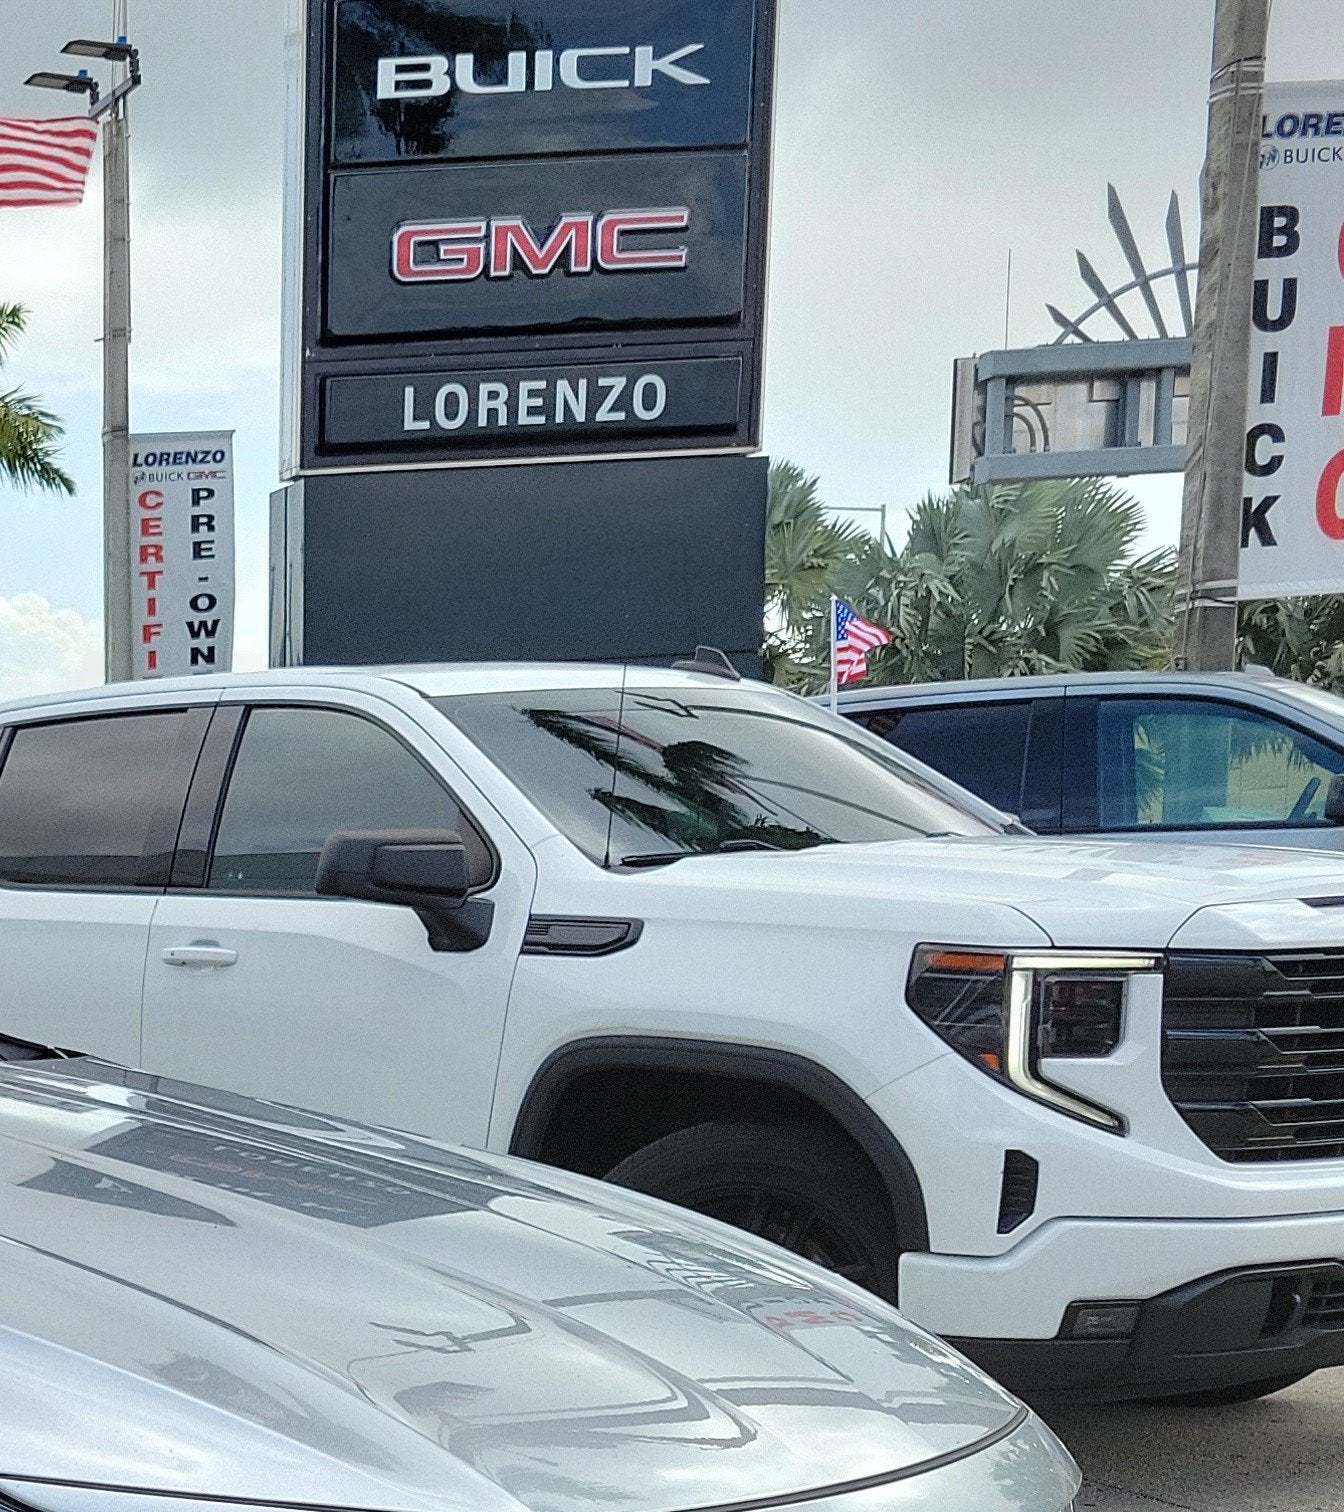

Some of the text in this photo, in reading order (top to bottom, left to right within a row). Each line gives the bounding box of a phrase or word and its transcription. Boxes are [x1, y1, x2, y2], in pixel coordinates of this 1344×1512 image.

[376, 43, 711, 100] BUICK
[1261, 111, 1344, 138] LORE
[1283, 146, 1344, 164] BUICK
[391, 206, 690, 284] GMC
[403, 374, 668, 432] LORENZO
[1240, 204, 1301, 548] BUICK
[132, 449, 226, 468] LORENZO
[148, 470, 226, 483] BUICK GMC
[137, 489, 164, 679] CERTIFI
[185, 487, 220, 674] PRE-OWN
